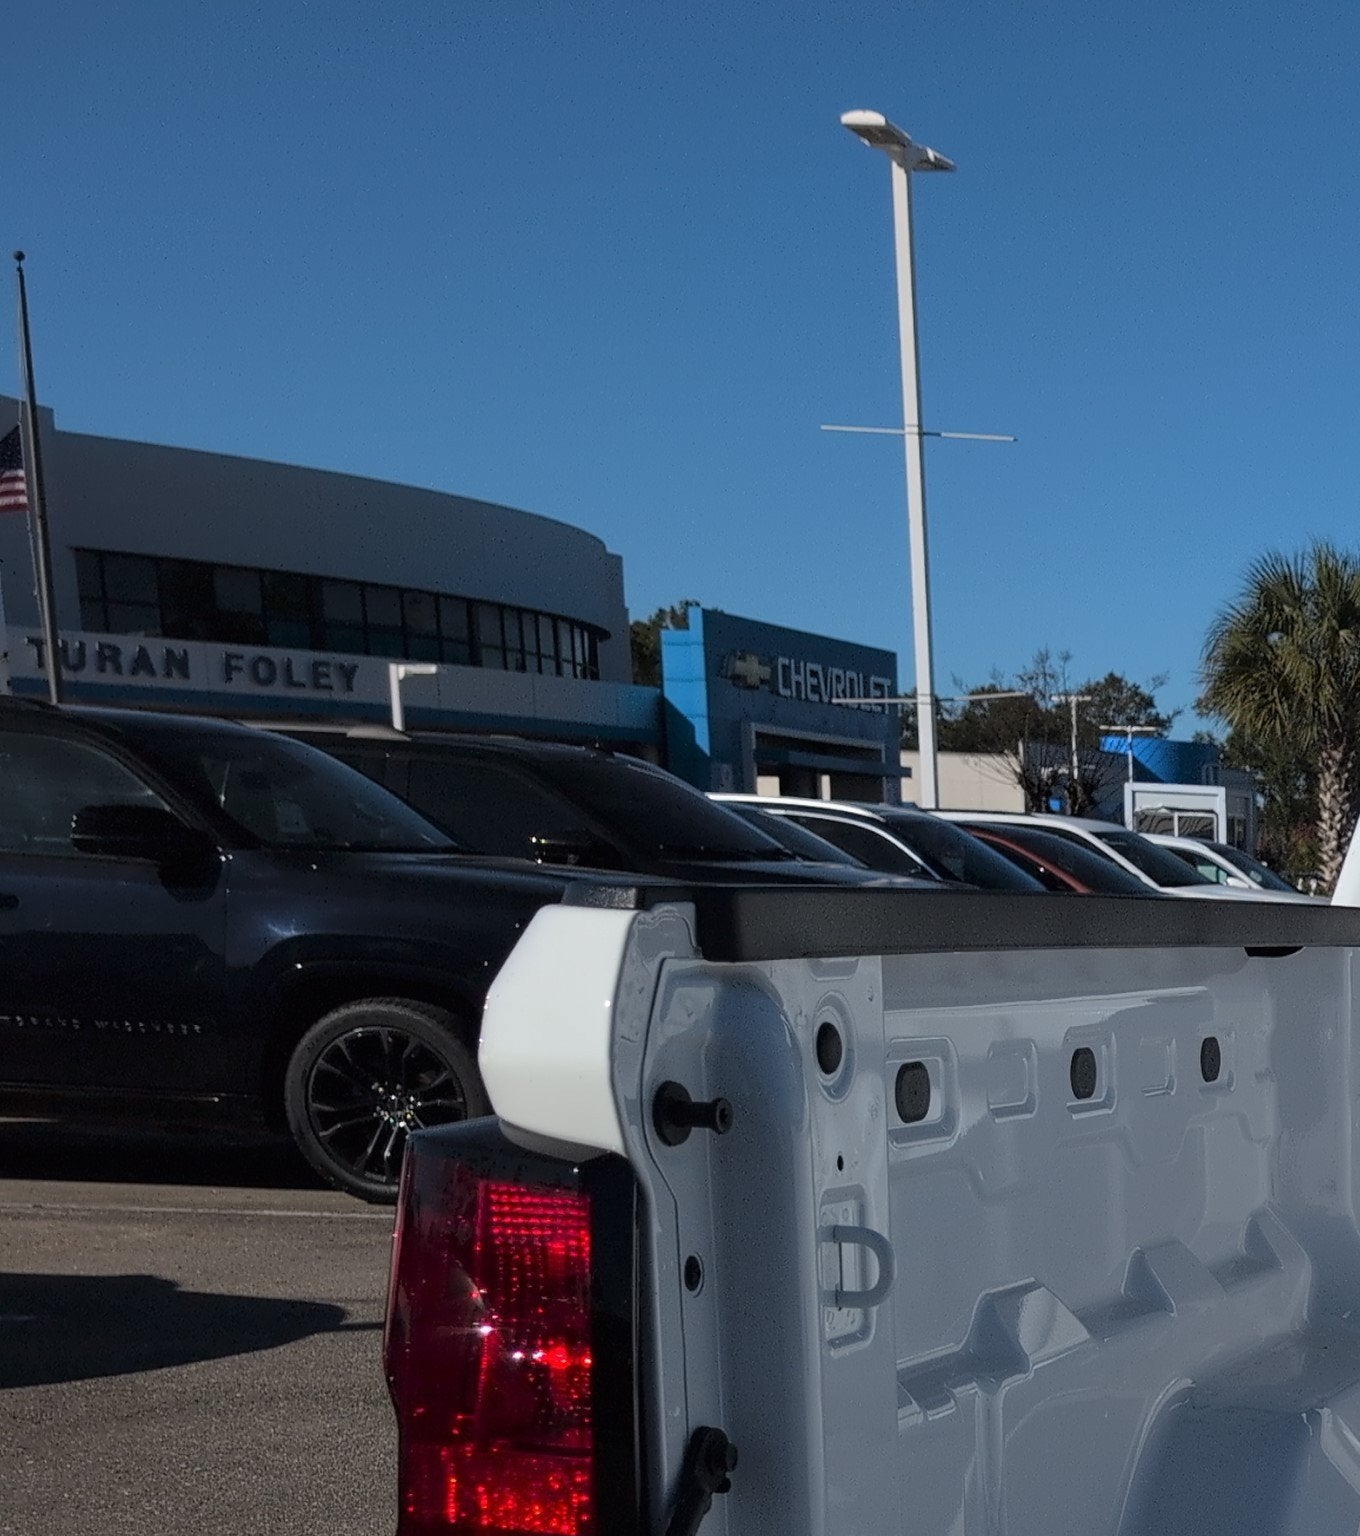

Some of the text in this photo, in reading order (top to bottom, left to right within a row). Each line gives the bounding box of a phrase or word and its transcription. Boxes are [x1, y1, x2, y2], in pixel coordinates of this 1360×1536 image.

[25, 636, 360, 693] TURAN FOLEY
[777, 656, 892, 715] CHEVROLET
